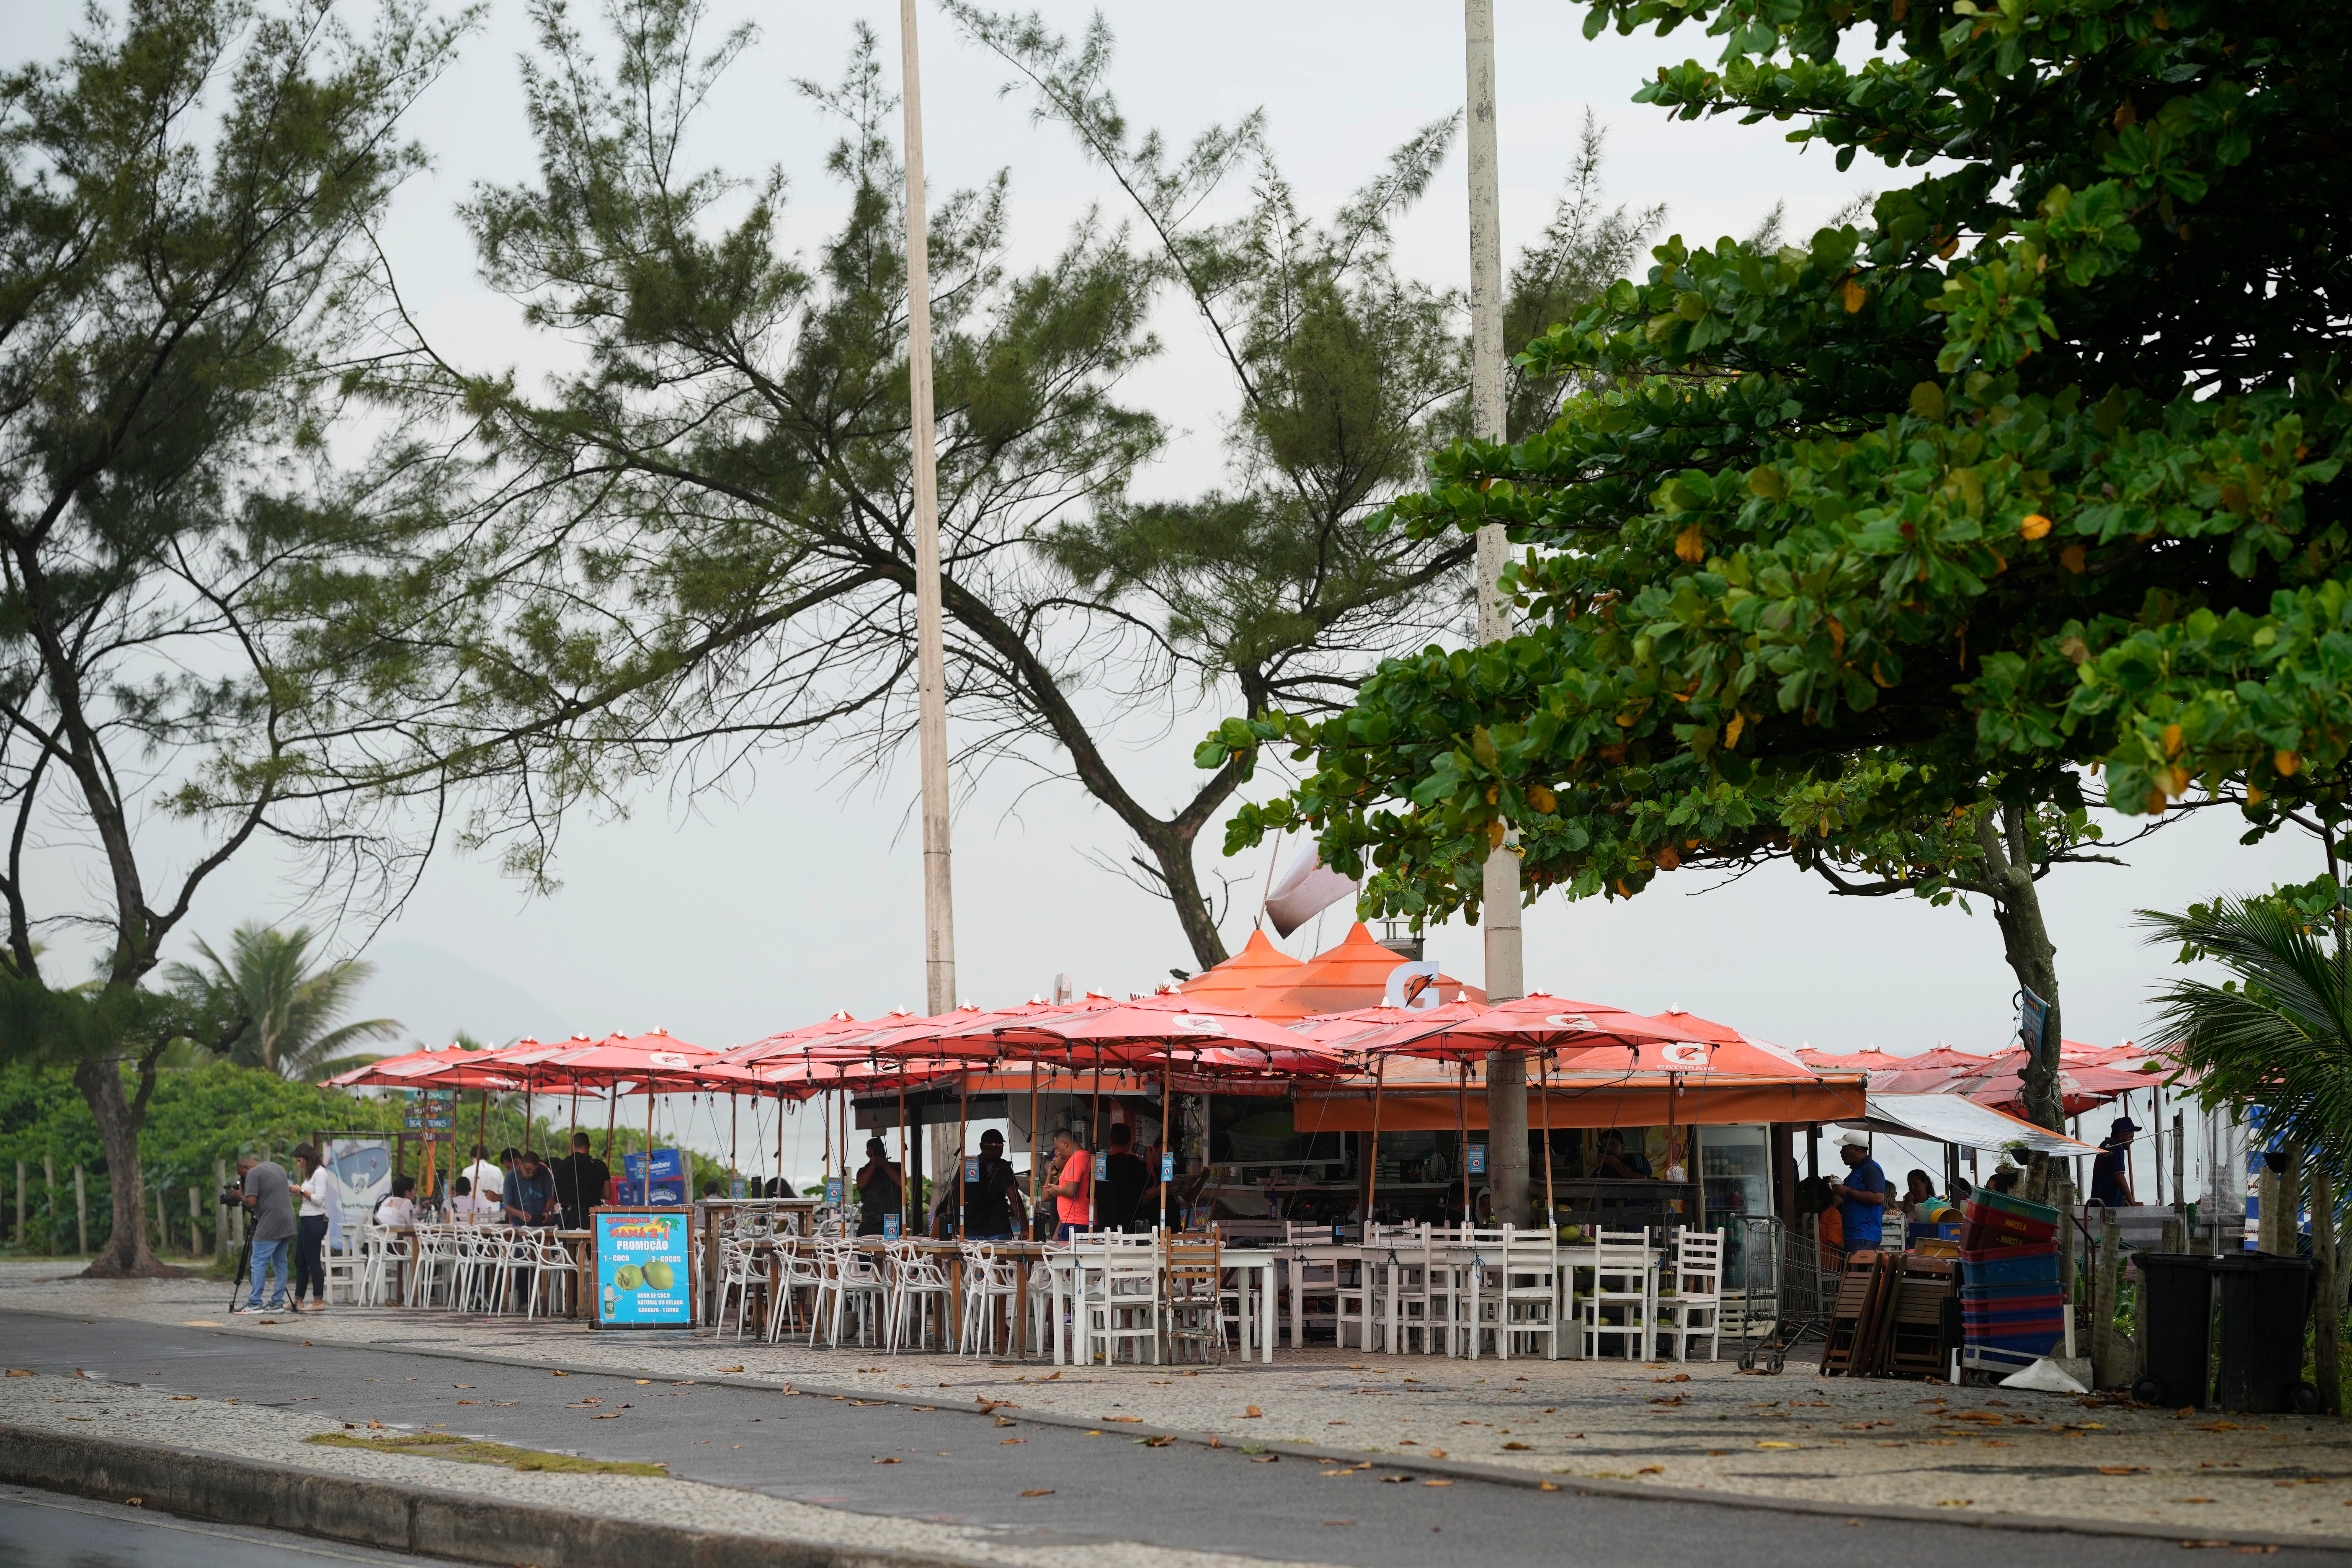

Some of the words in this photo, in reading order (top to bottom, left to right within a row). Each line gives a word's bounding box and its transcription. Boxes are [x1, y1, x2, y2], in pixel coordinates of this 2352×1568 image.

[649, 1161, 671, 1170] ambev
[2004, 1219, 2027, 1231] MARCELA
[609, 1227, 647, 1238] NANÁ
[649, 1228, 659, 1238] 2
[617, 1239, 668, 1252] PROMOÇÃO
[2000, 1235, 2023, 1246] MARCELA
